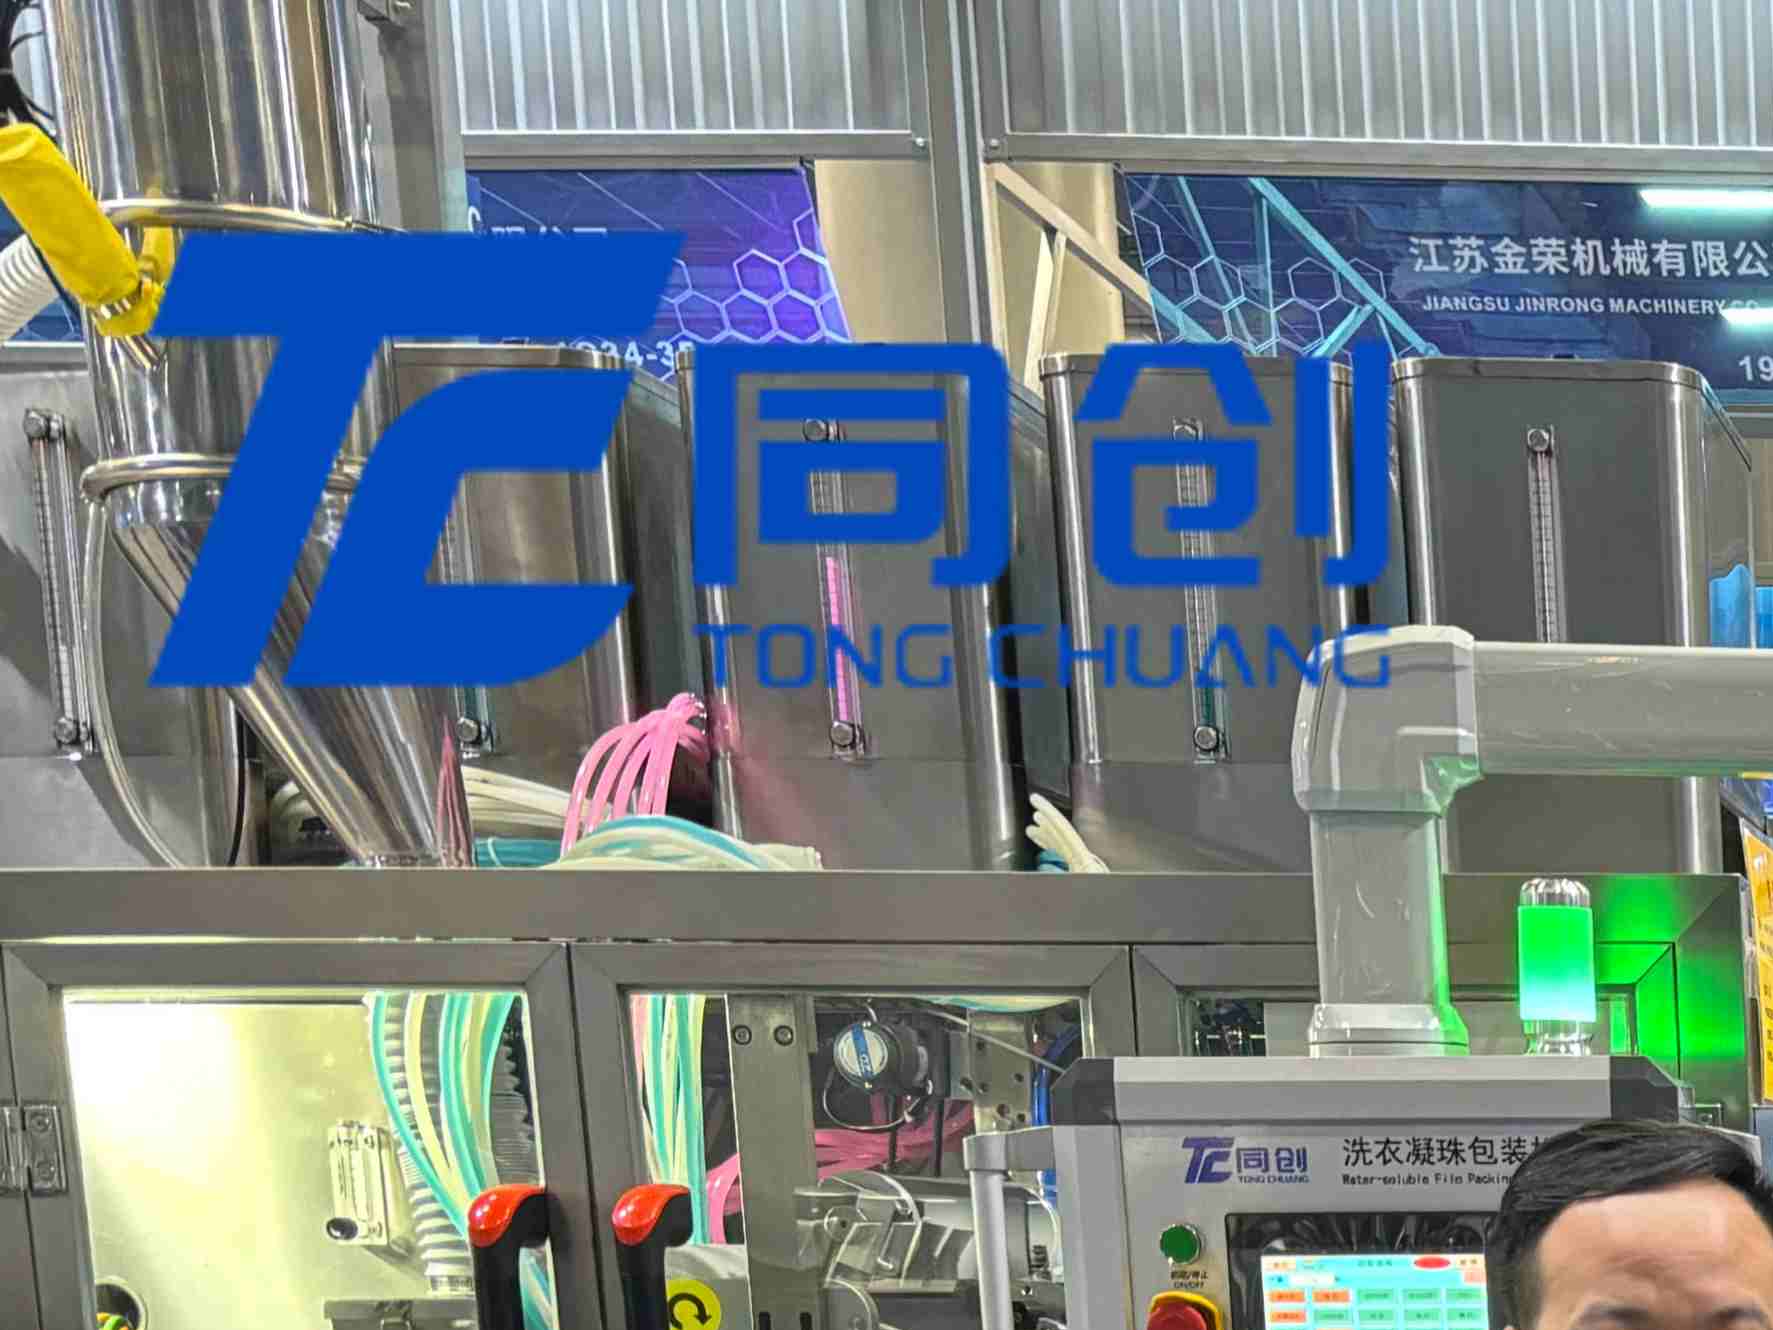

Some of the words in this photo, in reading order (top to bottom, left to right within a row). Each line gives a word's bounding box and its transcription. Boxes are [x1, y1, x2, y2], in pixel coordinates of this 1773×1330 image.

[1422, 294, 1510, 312] JIANGSU
[1515, 296, 1604, 313] JINRONG
[1609, 297, 1726, 315] MACHINERY
[1181, 1137, 1237, 1184] TC
[1236, 1147, 1308, 1174] 同创
